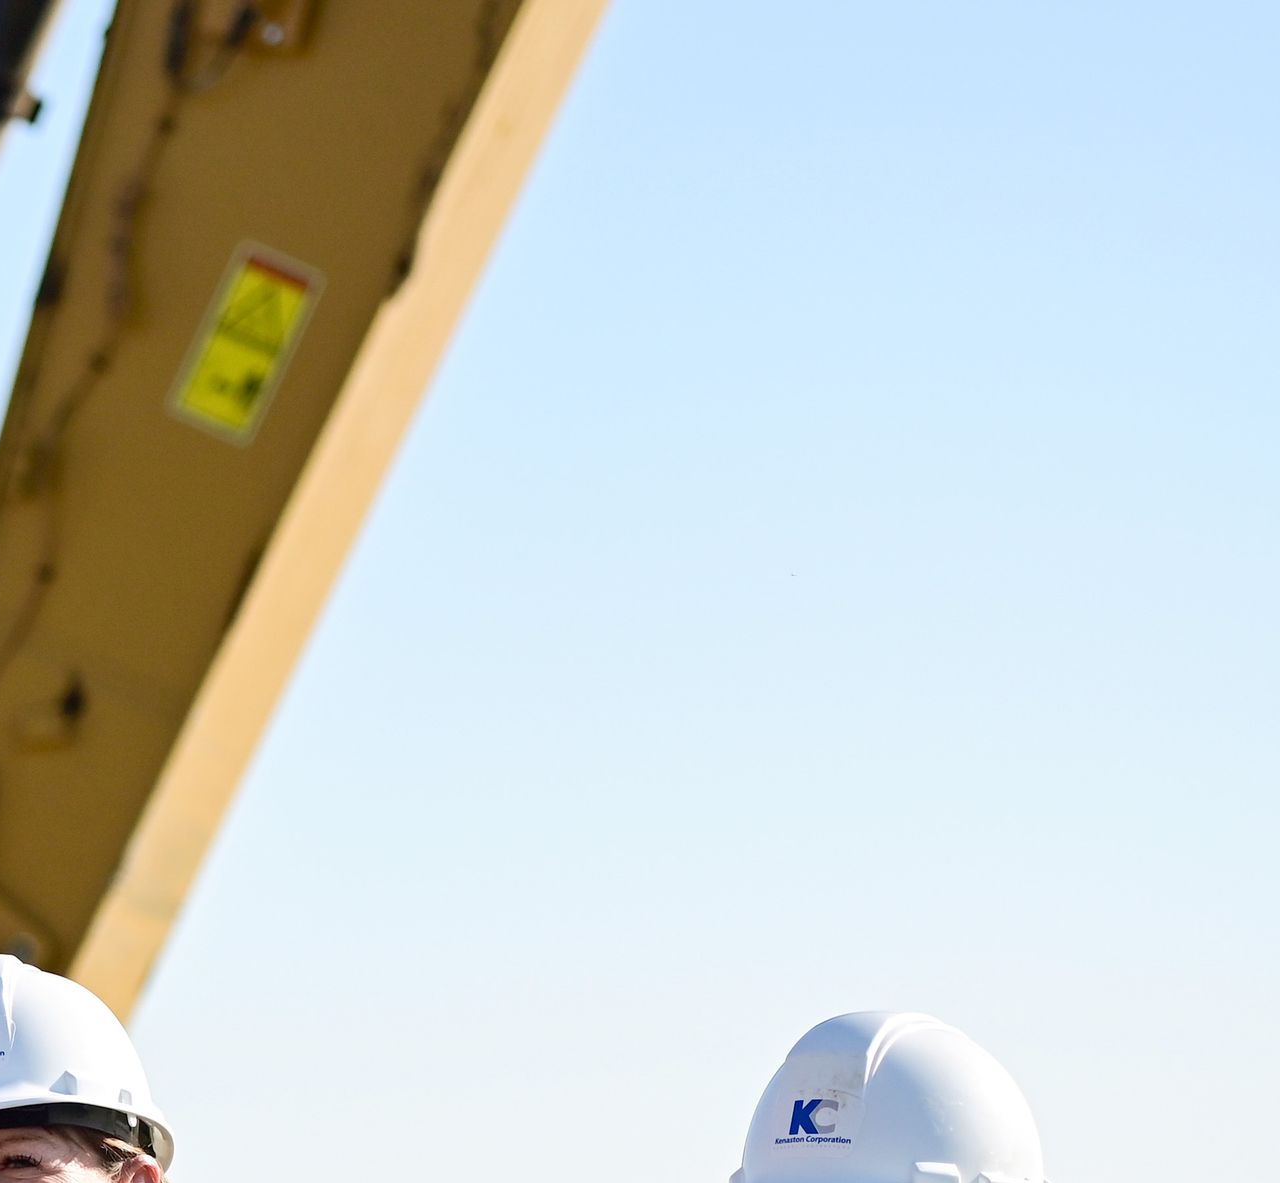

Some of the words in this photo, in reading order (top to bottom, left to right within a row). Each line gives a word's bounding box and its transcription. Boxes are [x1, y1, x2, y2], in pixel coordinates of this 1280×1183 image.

[788, 1099, 840, 1135] KC
[774, 1136, 805, 1145] Kenaston
[805, 1135, 852, 1145] Corporation
